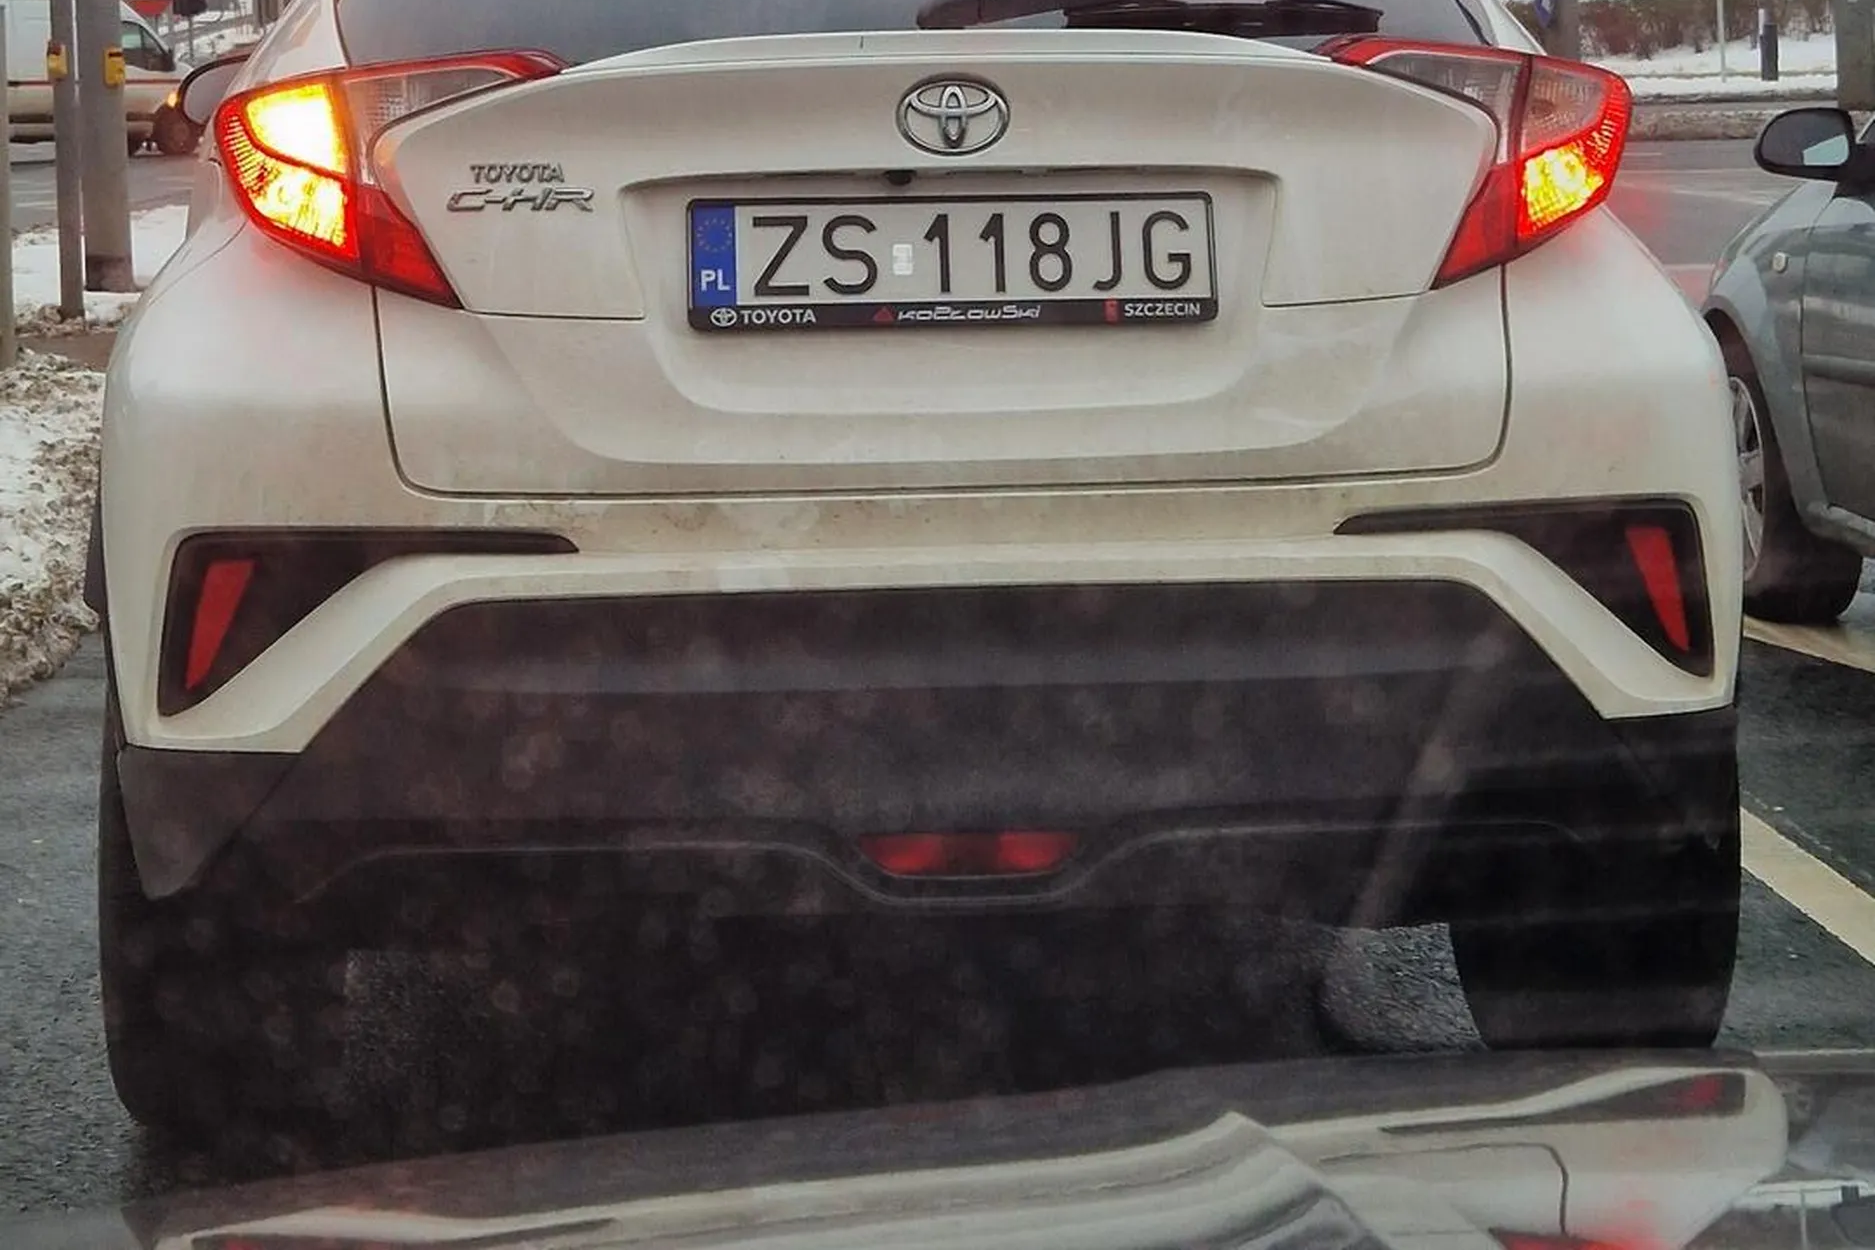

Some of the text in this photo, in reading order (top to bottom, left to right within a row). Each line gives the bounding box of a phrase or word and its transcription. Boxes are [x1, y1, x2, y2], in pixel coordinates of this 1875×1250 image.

[470, 162, 565, 183] TOYOTA
[446, 187, 595, 212] C-HR
[752, 210, 1192, 296] ZS 118JG
[700, 269, 730, 291] PL
[740, 308, 817, 324] TOYOTA
[1124, 302, 1200, 317] SZCZECIN
